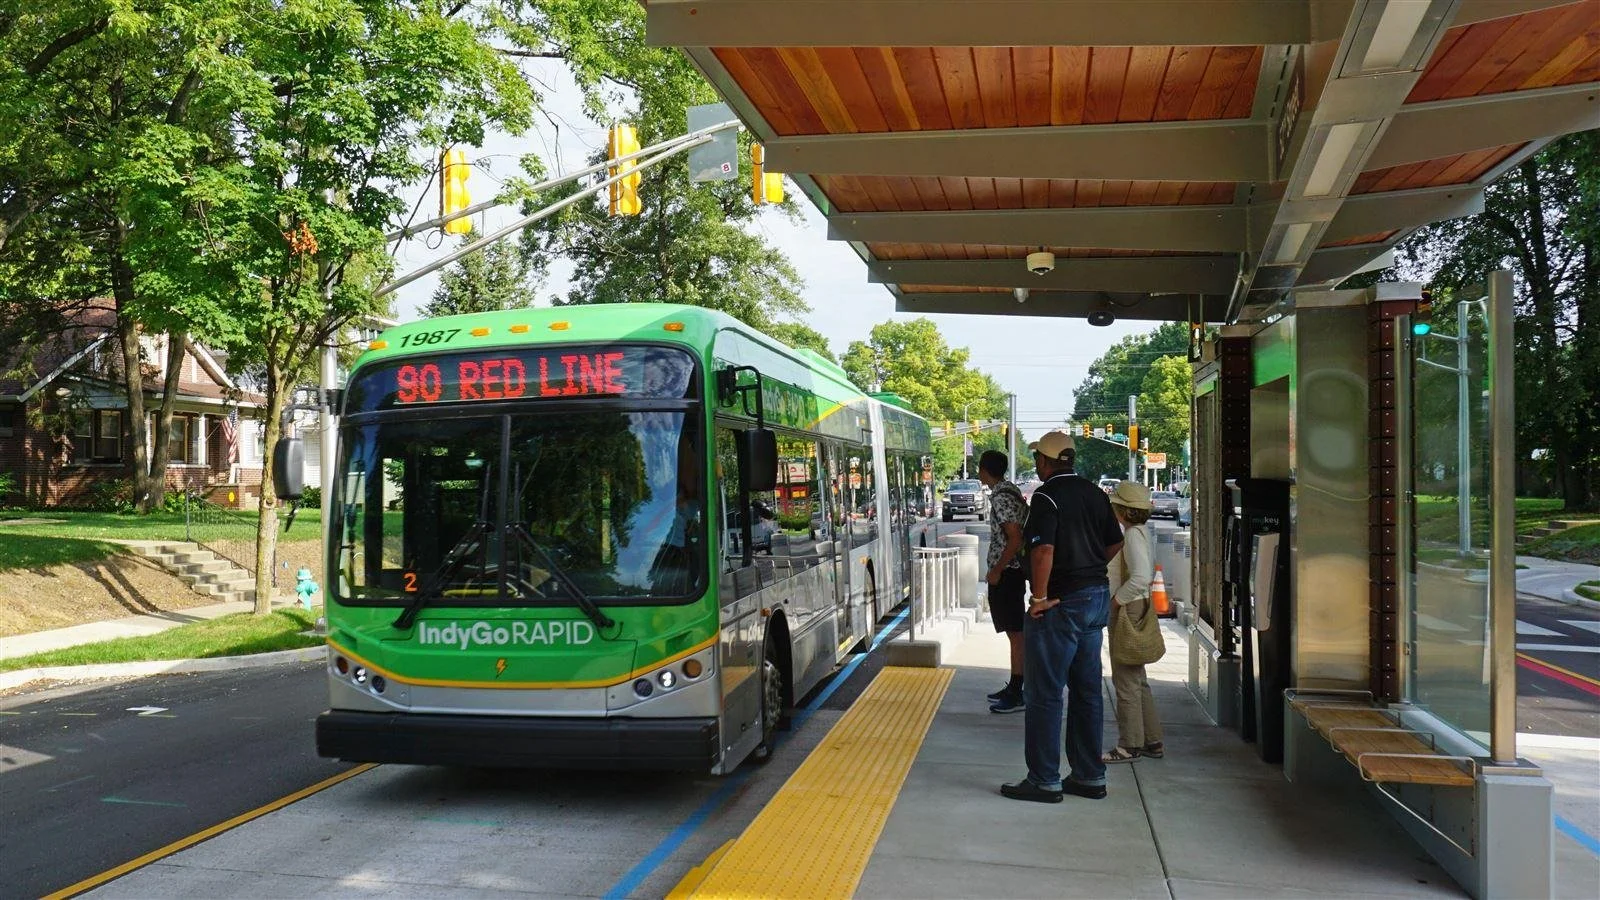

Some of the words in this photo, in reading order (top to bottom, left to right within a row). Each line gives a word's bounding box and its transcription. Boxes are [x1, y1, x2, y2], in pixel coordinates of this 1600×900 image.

[401, 329, 461, 348] 1987
[397, 362, 441, 402] 90
[459, 358, 526, 400] RED
[539, 352, 625, 396] LINE
[404, 573, 417, 592] 2
[419, 621, 509, 650] IndyGo
[512, 621, 593, 645] RAPID
